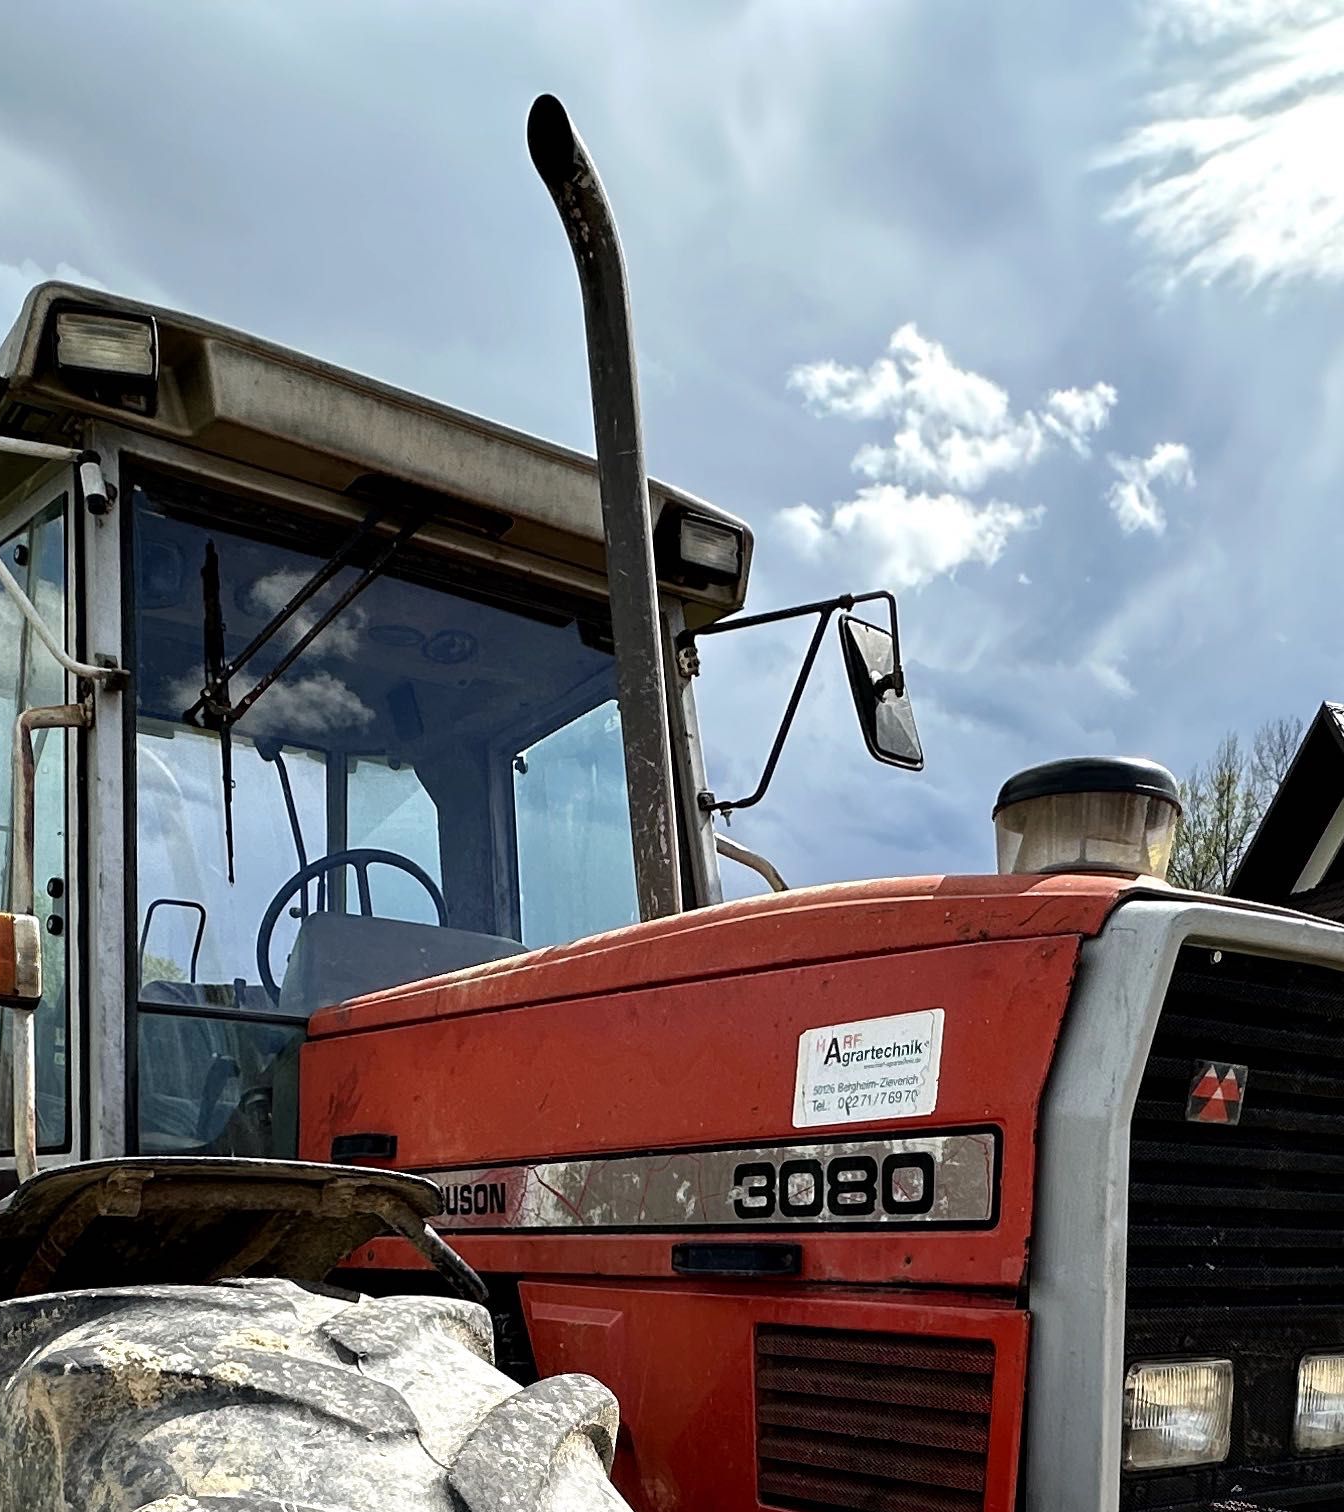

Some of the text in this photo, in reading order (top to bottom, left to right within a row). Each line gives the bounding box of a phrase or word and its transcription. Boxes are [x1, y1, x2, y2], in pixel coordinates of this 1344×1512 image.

[824, 1037, 923, 1067] Agrartechnik
[440, 1152, 935, 1219] USON 3080
